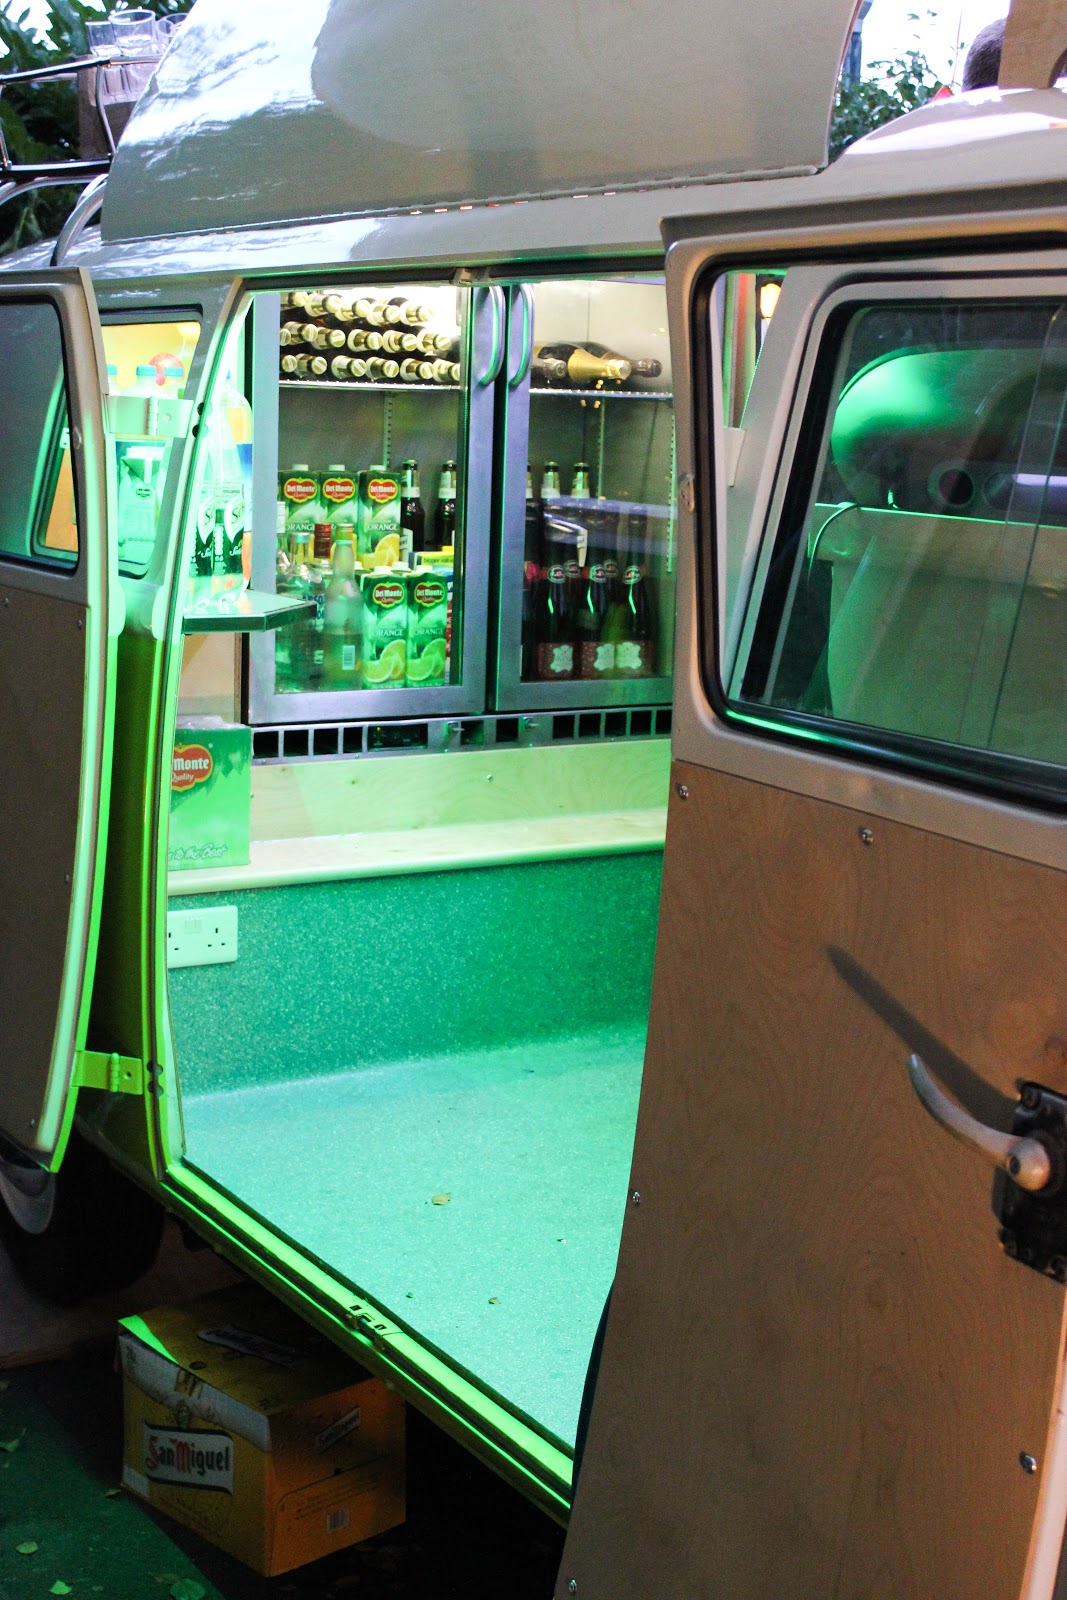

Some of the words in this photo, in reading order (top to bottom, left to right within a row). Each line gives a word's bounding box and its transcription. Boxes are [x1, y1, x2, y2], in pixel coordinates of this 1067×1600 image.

[367, 523, 398, 531] ORANGE
[373, 628, 404, 637] ORANGE
[173, 757, 209, 771] Monte
[200, 842, 228, 859] Best
